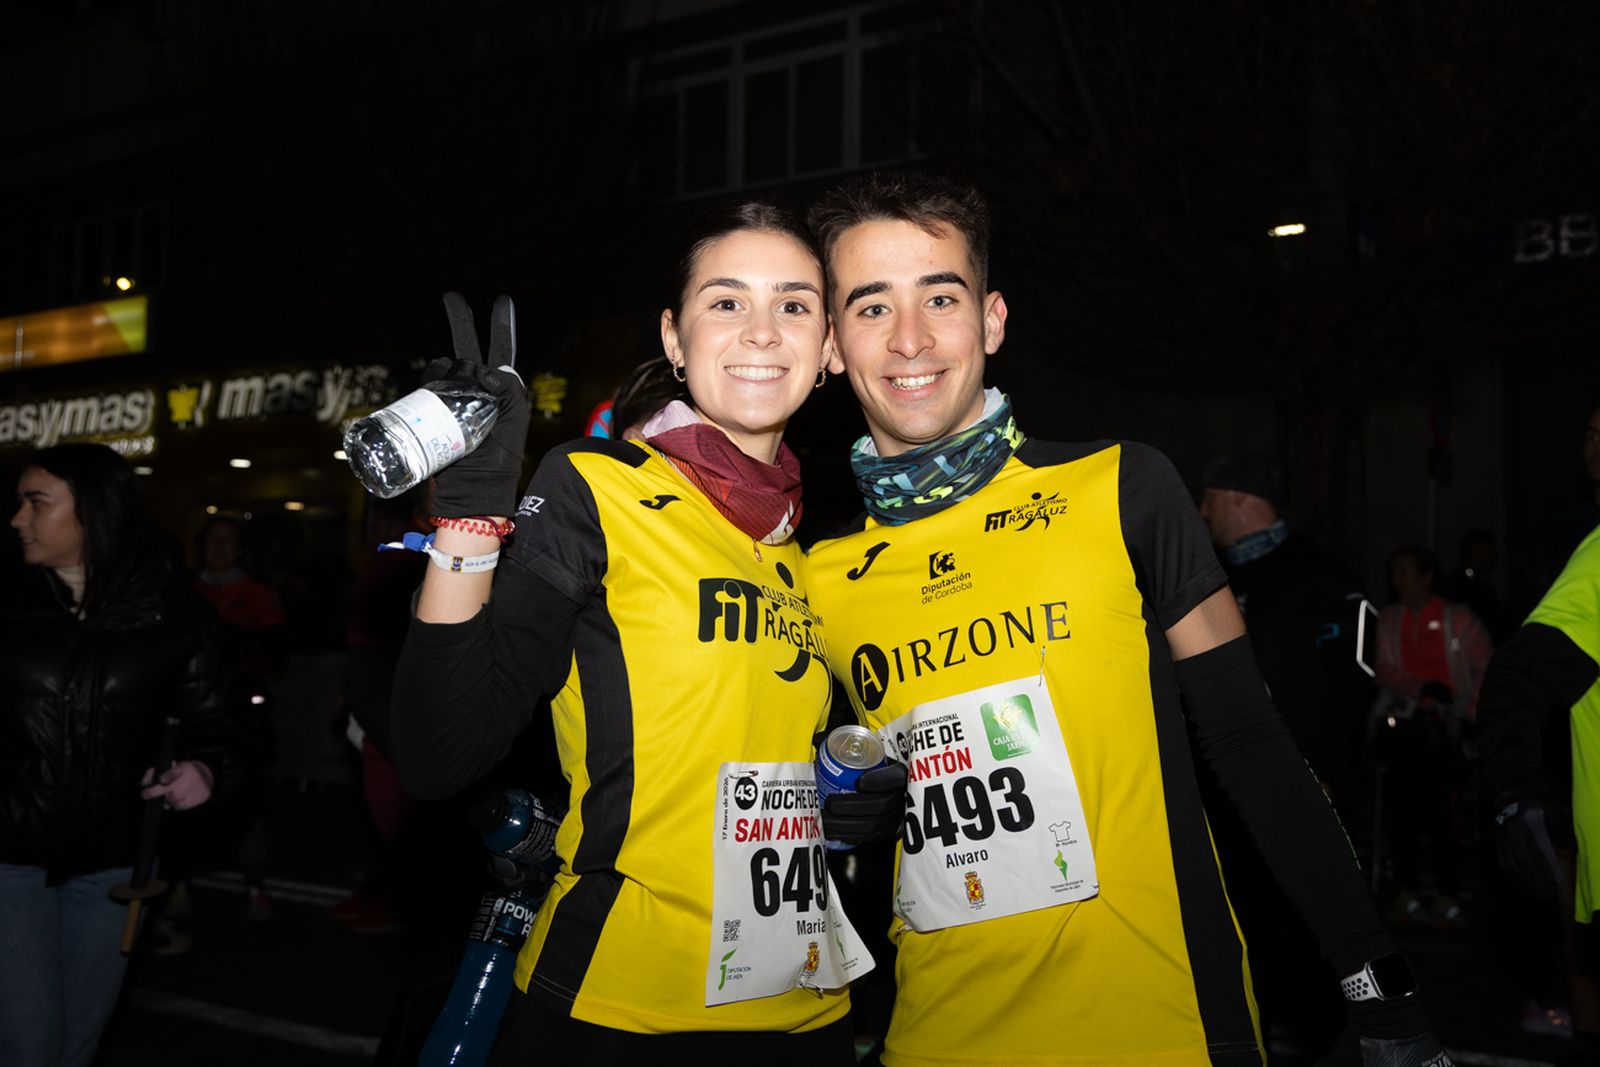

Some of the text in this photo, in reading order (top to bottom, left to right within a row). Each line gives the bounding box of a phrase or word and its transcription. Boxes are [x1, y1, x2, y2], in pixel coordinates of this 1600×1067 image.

[761, 584, 788, 606] CLUB
[921, 571, 971, 596] Diputación
[921, 594, 933, 605] de
[851, 601, 1071, 711] AIRZONE
[939, 722, 965, 746] DE
[908, 745, 973, 784] ANTÓN
[761, 789, 819, 811] NOCHE DE
[903, 766, 1036, 855] 6493
[735, 809, 821, 842] SAN ANTÓN
[945, 849, 989, 869] Alvaro
[750, 845, 828, 917] 649
